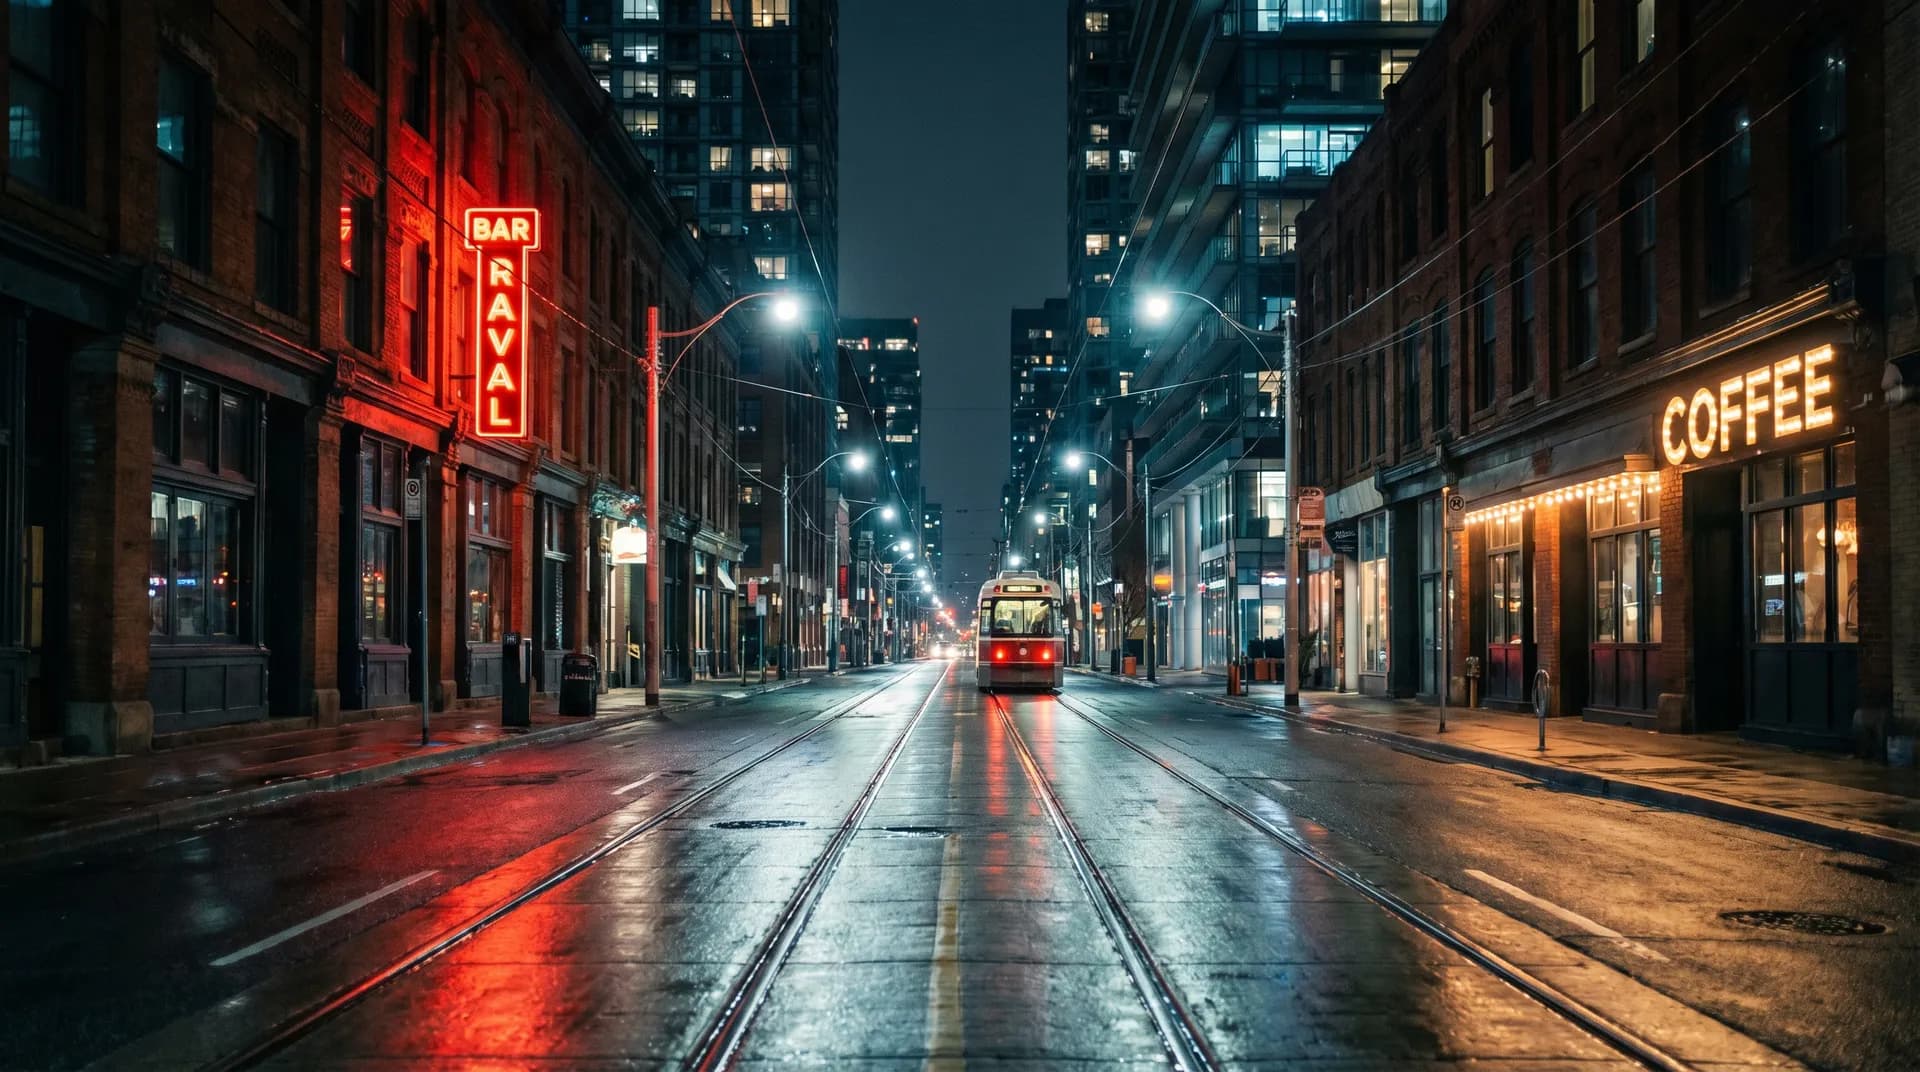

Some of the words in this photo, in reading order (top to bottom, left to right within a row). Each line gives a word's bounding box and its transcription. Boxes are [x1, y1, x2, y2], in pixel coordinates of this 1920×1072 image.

[472, 217, 530, 241] BAR
[486, 257, 516, 426] RAVAL
[1662, 343, 1833, 466] COFFEE
